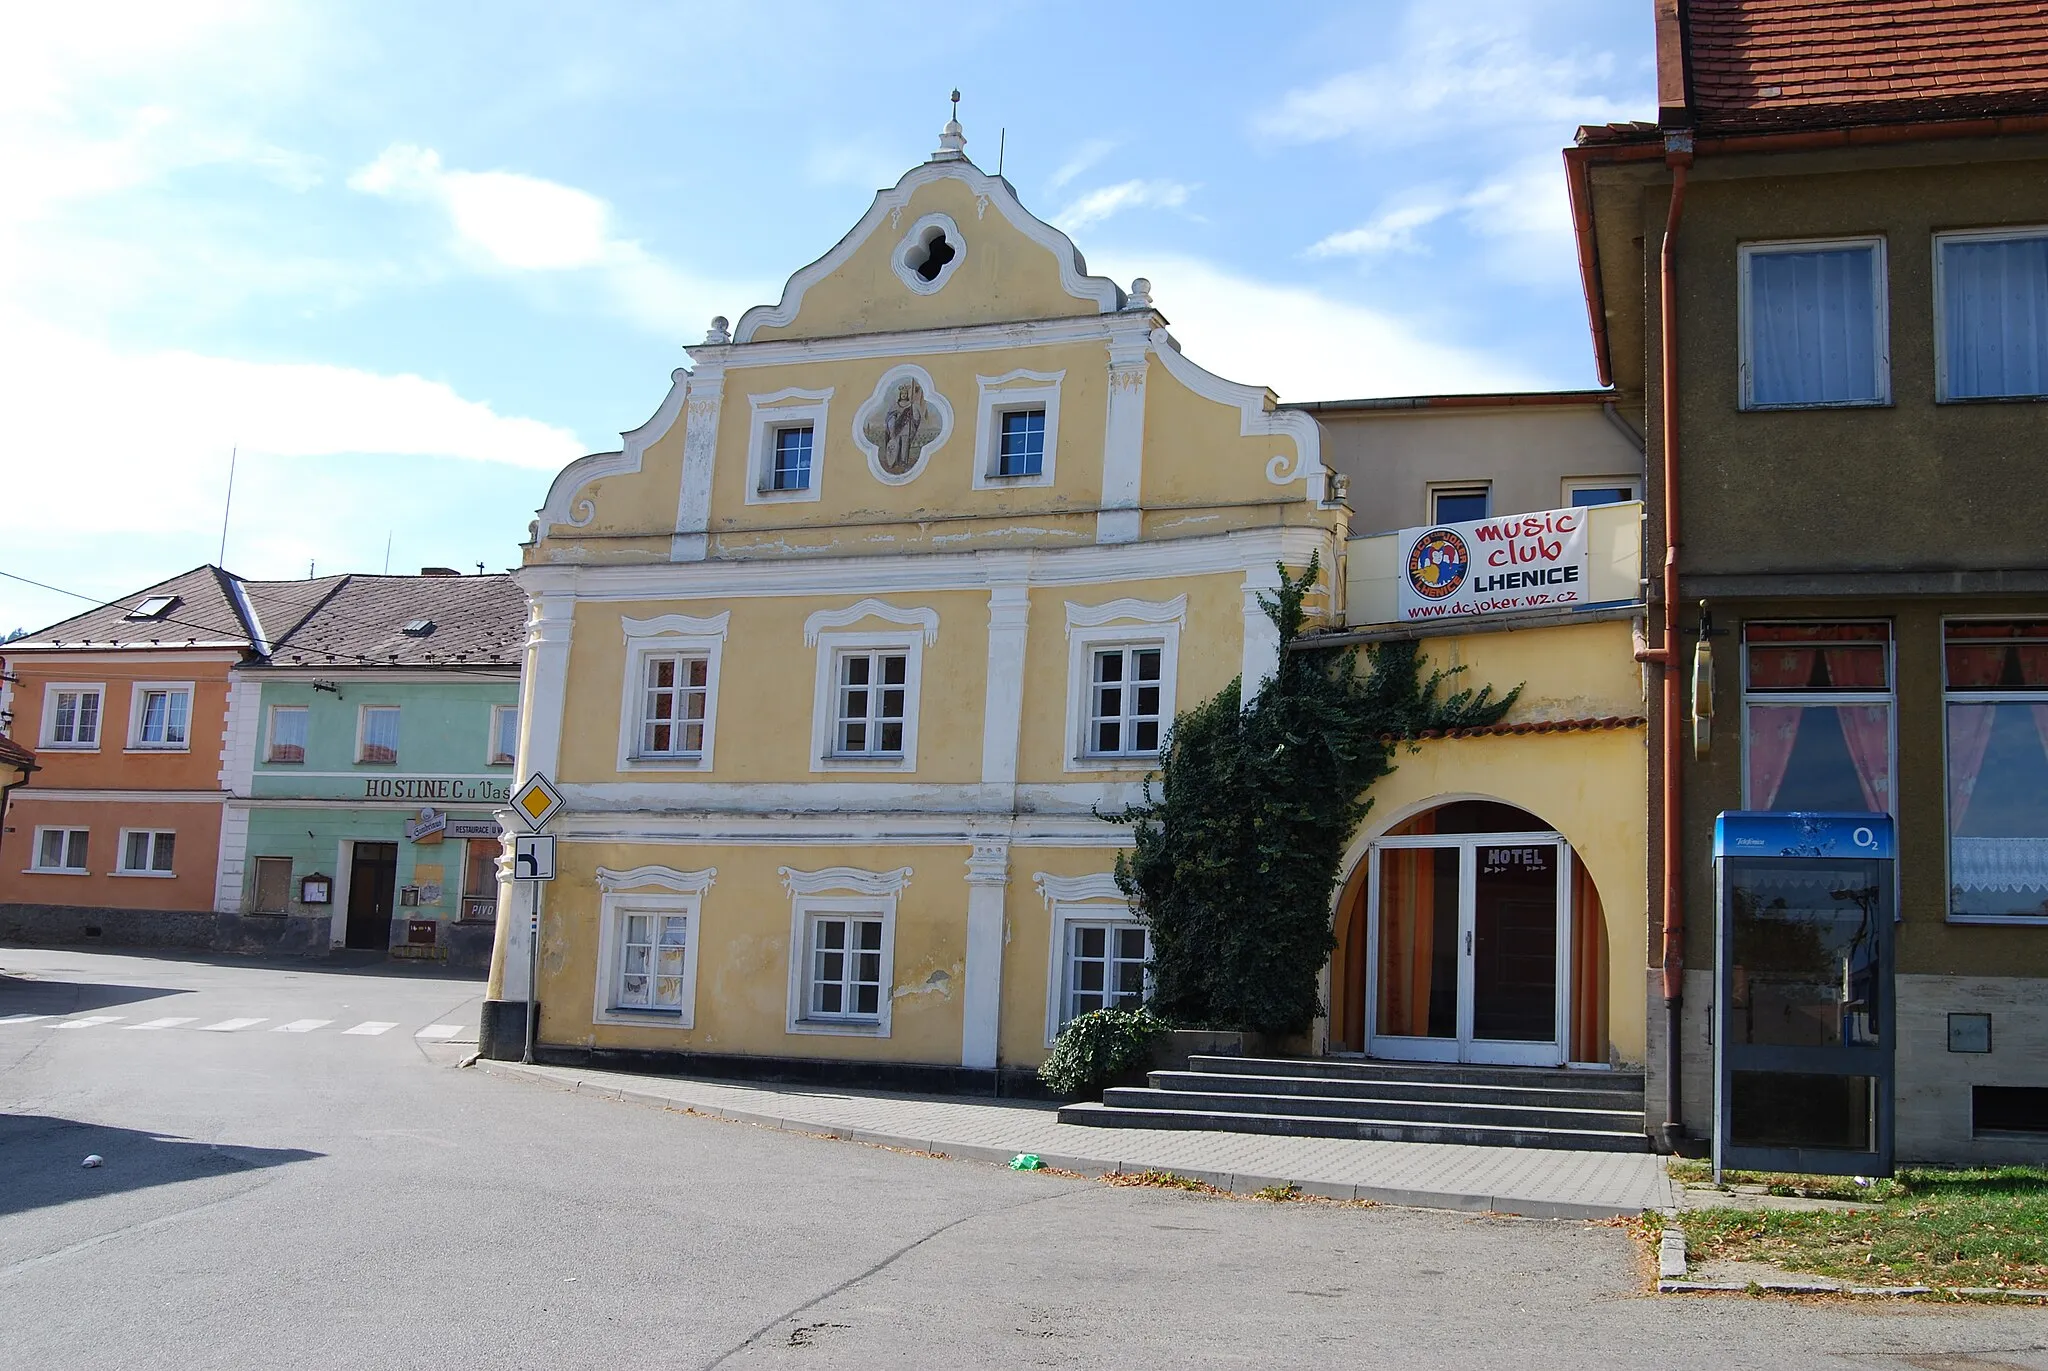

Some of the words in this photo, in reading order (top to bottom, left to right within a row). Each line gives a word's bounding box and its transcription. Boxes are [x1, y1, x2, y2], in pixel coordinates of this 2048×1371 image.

[1475, 512, 1576, 543] music
[1410, 537, 1431, 570] DISCO
[1443, 533, 1467, 564] JOKER
[1487, 537, 1563, 567] club
[1415, 575, 1462, 597] LHENICE
[1474, 565, 1579, 593] LHENICE
[1408, 590, 1578, 619] www.dcjoker.wz.cz
[364, 779, 464, 799] HOSTINEC
[480, 780, 511, 800] Vaš
[455, 826, 489, 834] RESTAURACE
[491, 826, 497, 834] U
[1853, 827, 1879, 851] O2
[1487, 849, 1543, 865] HOTEL
[471, 904, 494, 916] PIVO
